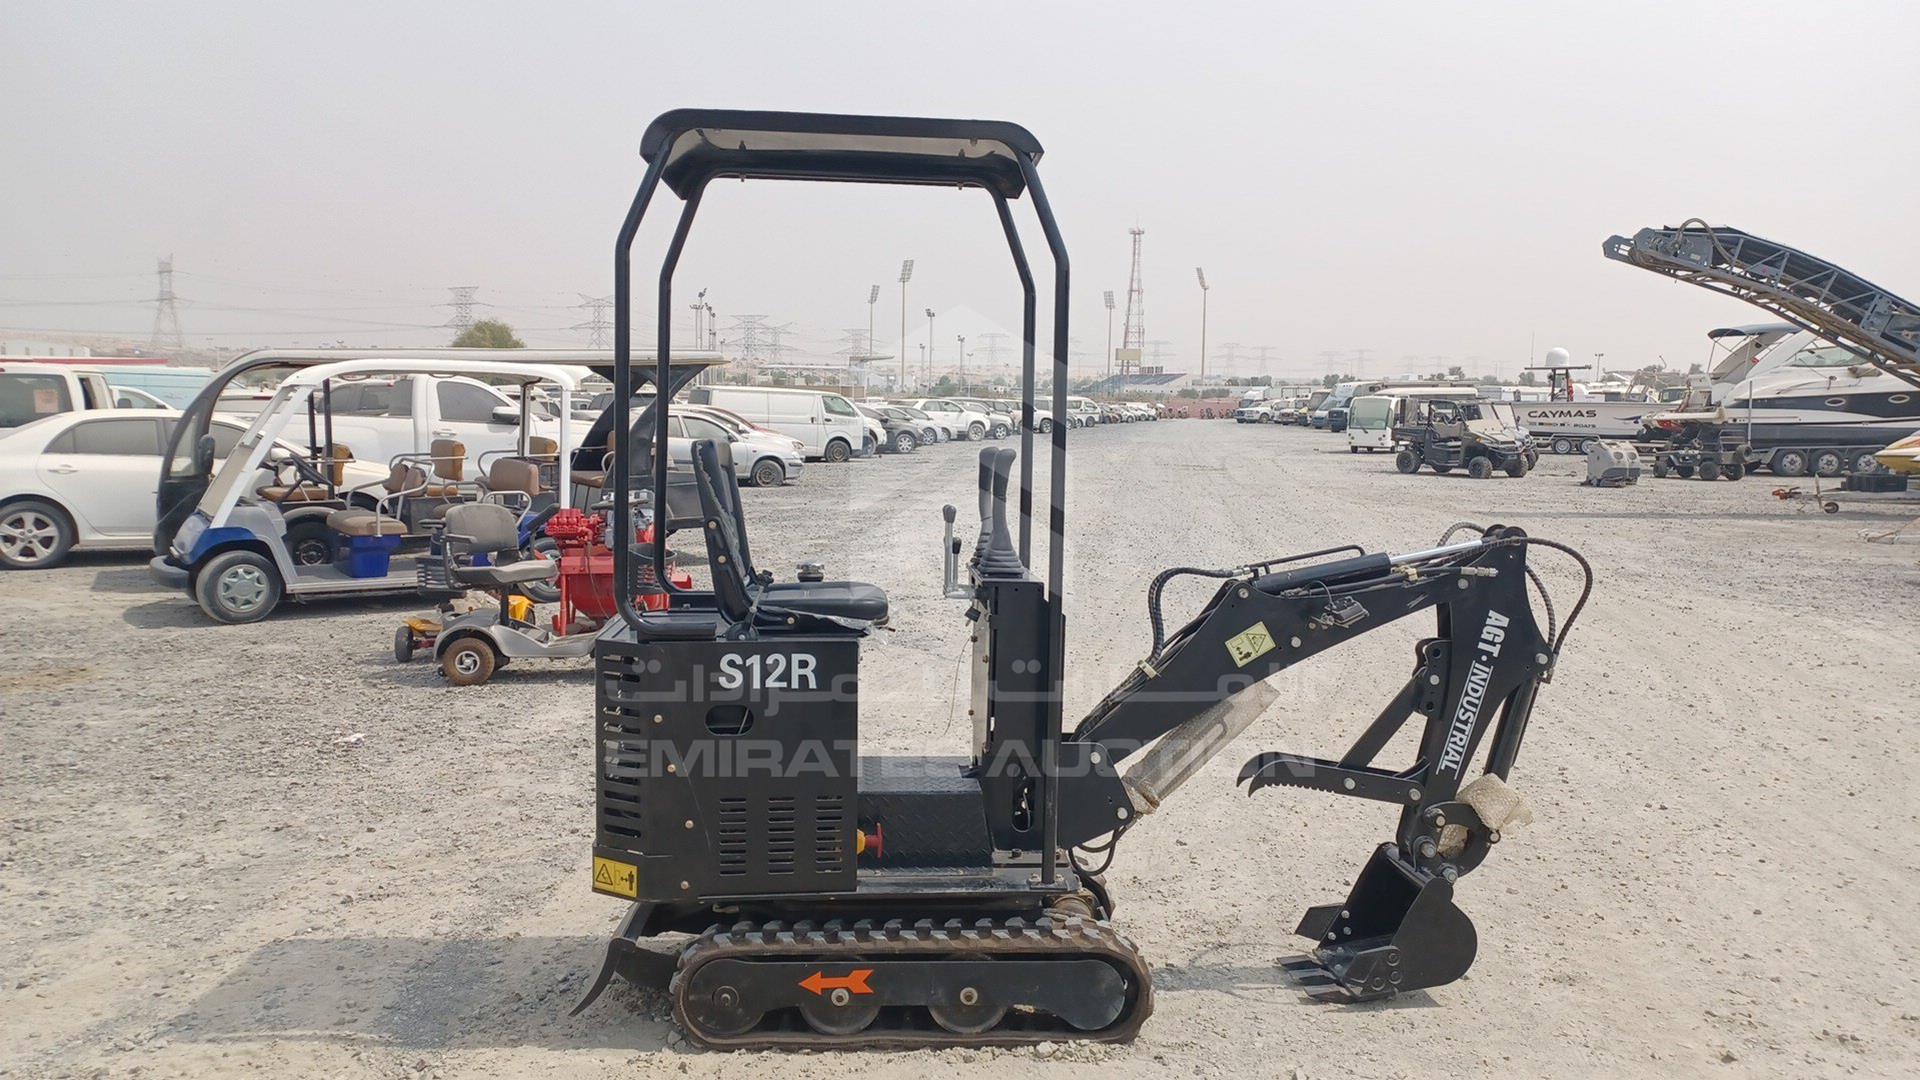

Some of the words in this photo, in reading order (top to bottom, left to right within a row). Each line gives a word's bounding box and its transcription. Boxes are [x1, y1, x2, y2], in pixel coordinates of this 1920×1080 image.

[1527, 409, 1597, 419] CAYMAS
[1477, 609, 1510, 658] AGT
[718, 653, 817, 689] S12R
[1440, 662, 1490, 771] INDUSTRIAL
